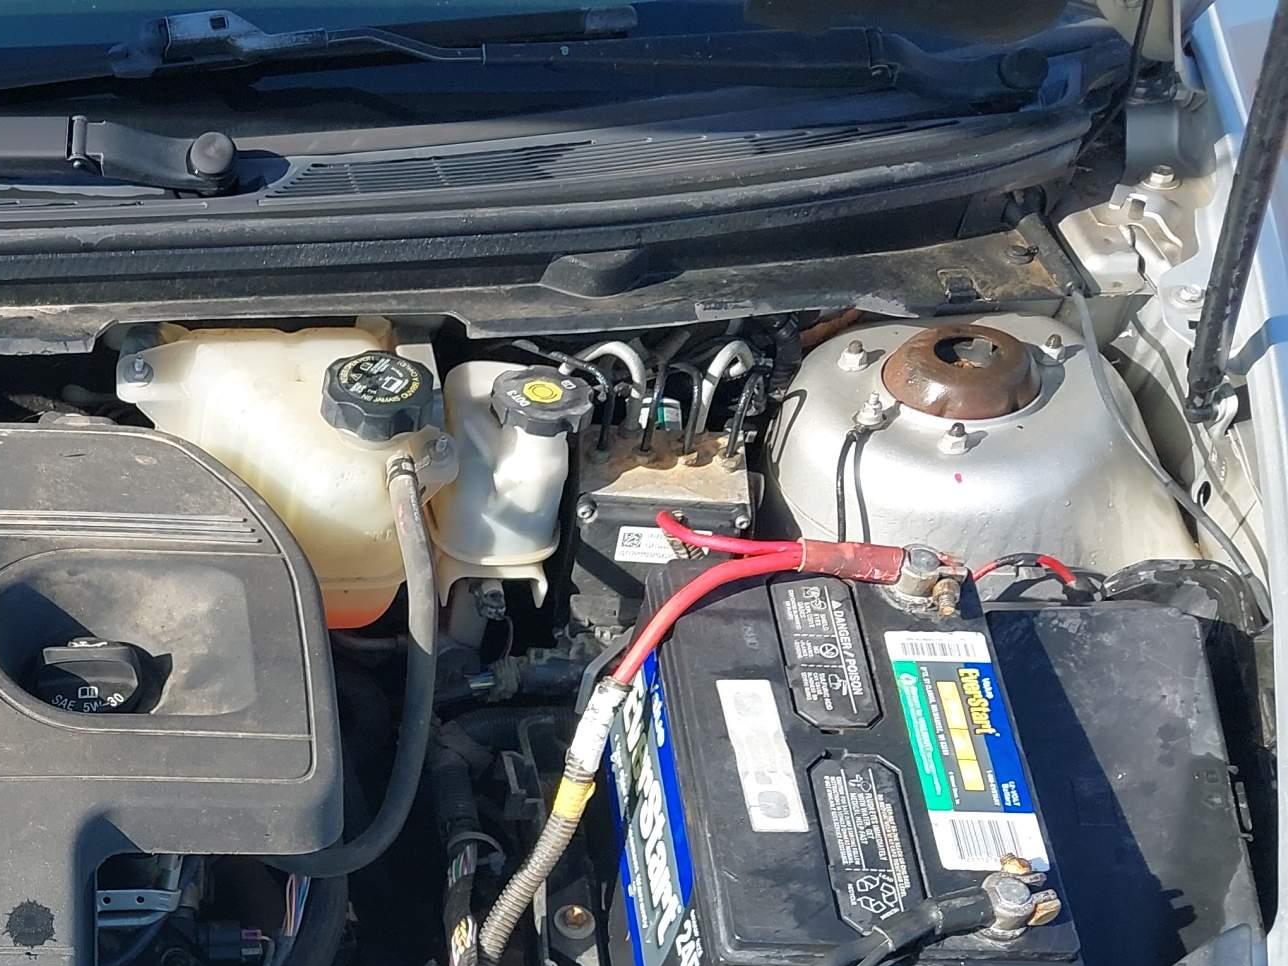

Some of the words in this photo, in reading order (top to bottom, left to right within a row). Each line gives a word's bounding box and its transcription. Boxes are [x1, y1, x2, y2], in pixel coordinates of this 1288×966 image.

[832, 610, 852, 649] DANGER
[845, 659, 864, 696] POISON
[52, 694, 75, 710] SAE
[83, 692, 124, 712] 5W-30
